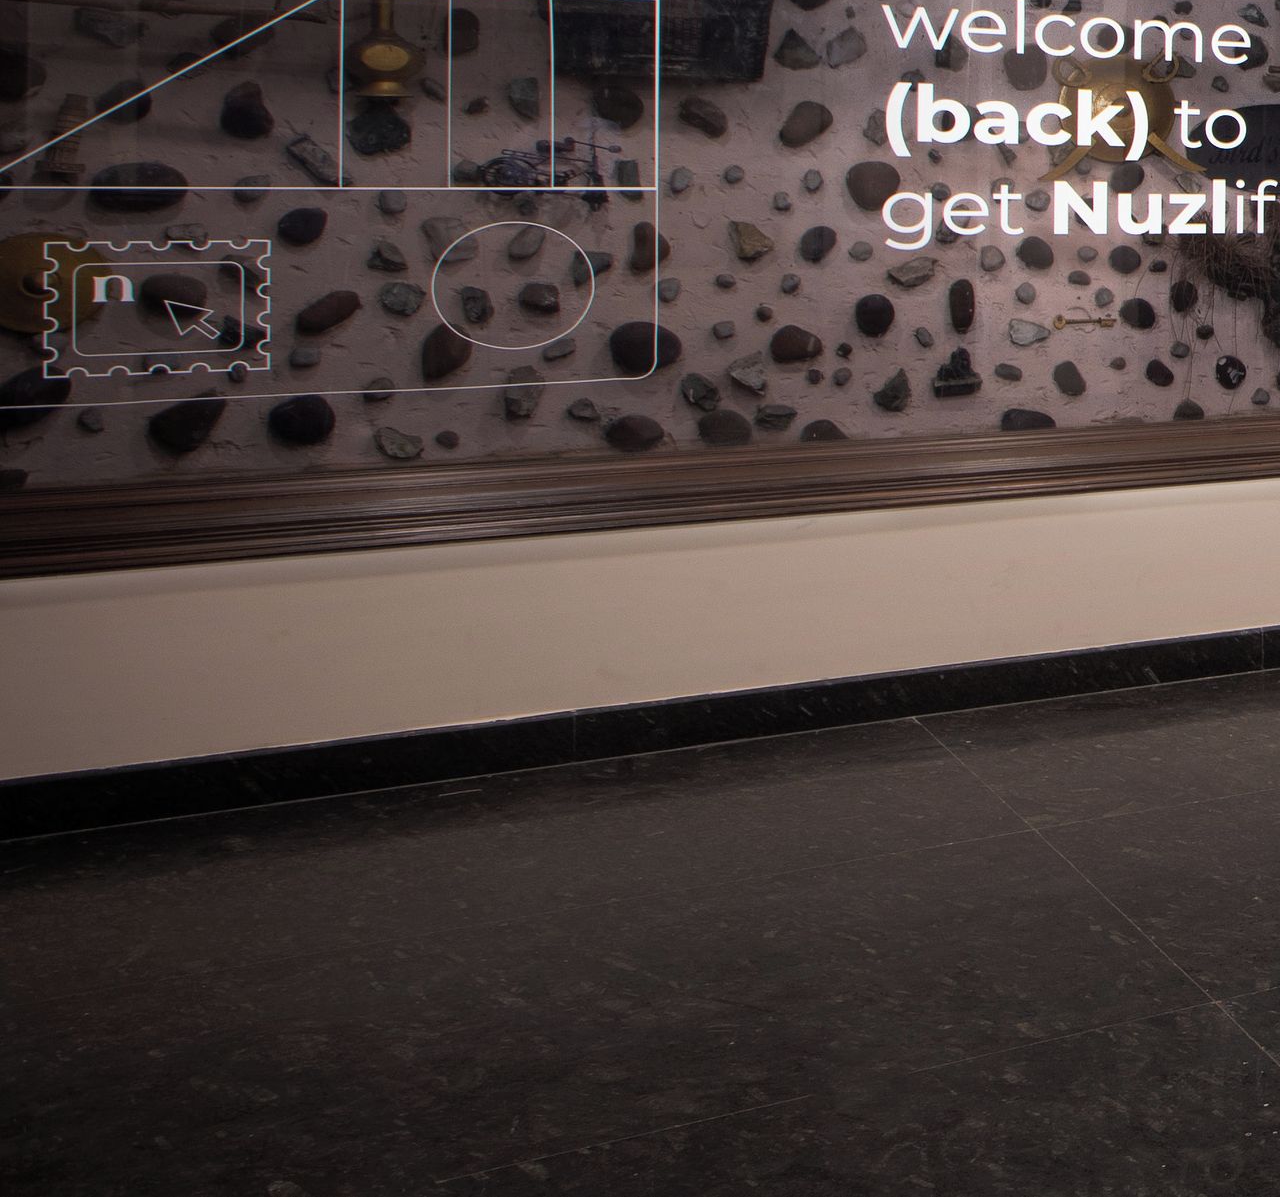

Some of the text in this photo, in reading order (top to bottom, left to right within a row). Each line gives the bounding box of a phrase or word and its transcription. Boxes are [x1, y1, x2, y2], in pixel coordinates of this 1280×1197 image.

[885, 81, 1247, 161] (back) to
[881, 183, 1025, 251] get
